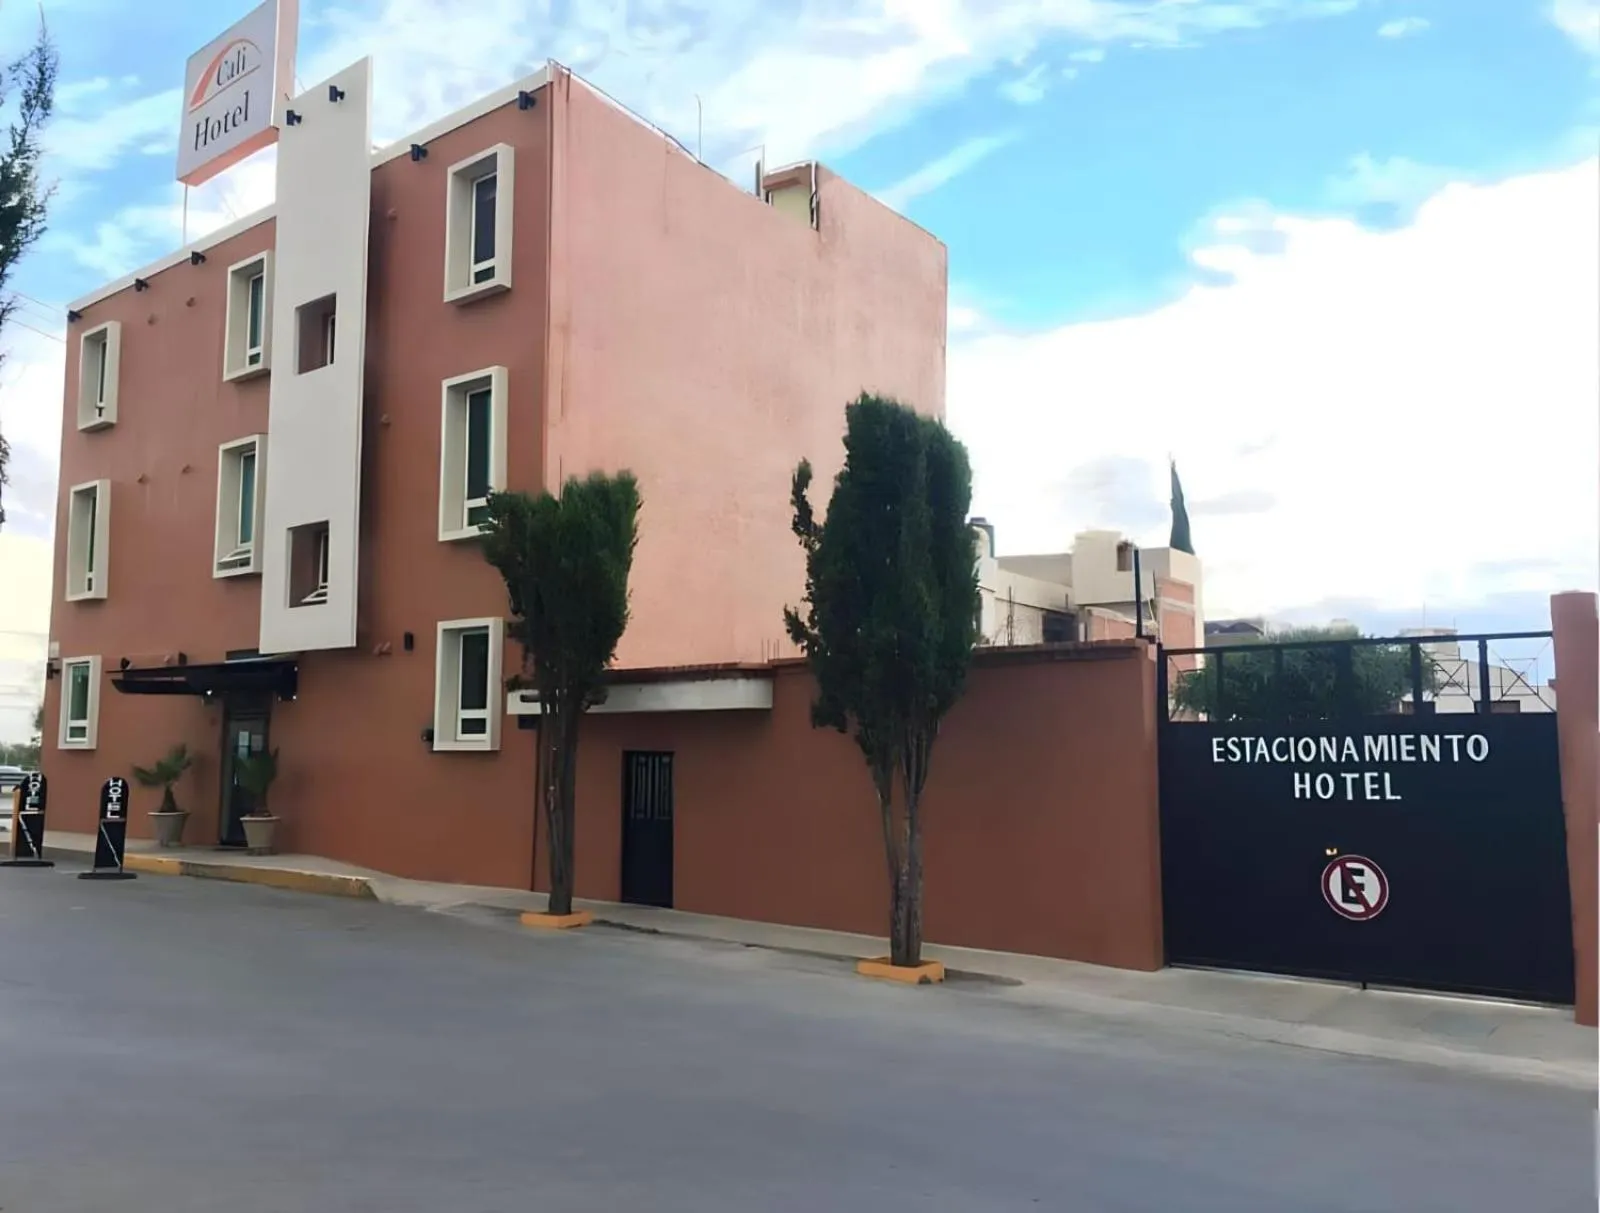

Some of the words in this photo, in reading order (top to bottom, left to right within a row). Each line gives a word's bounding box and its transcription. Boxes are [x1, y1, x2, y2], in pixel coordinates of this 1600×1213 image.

[216, 47, 247, 87] Cali
[194, 90, 250, 152] Hotel
[1211, 734, 1490, 763] ESTACIONAMIENTO
[25, 771, 42, 811] HOTEL
[107, 778, 123, 819] HOTEL
[1293, 771, 1402, 801] HOTEL
[1340, 866, 1366, 905] E
